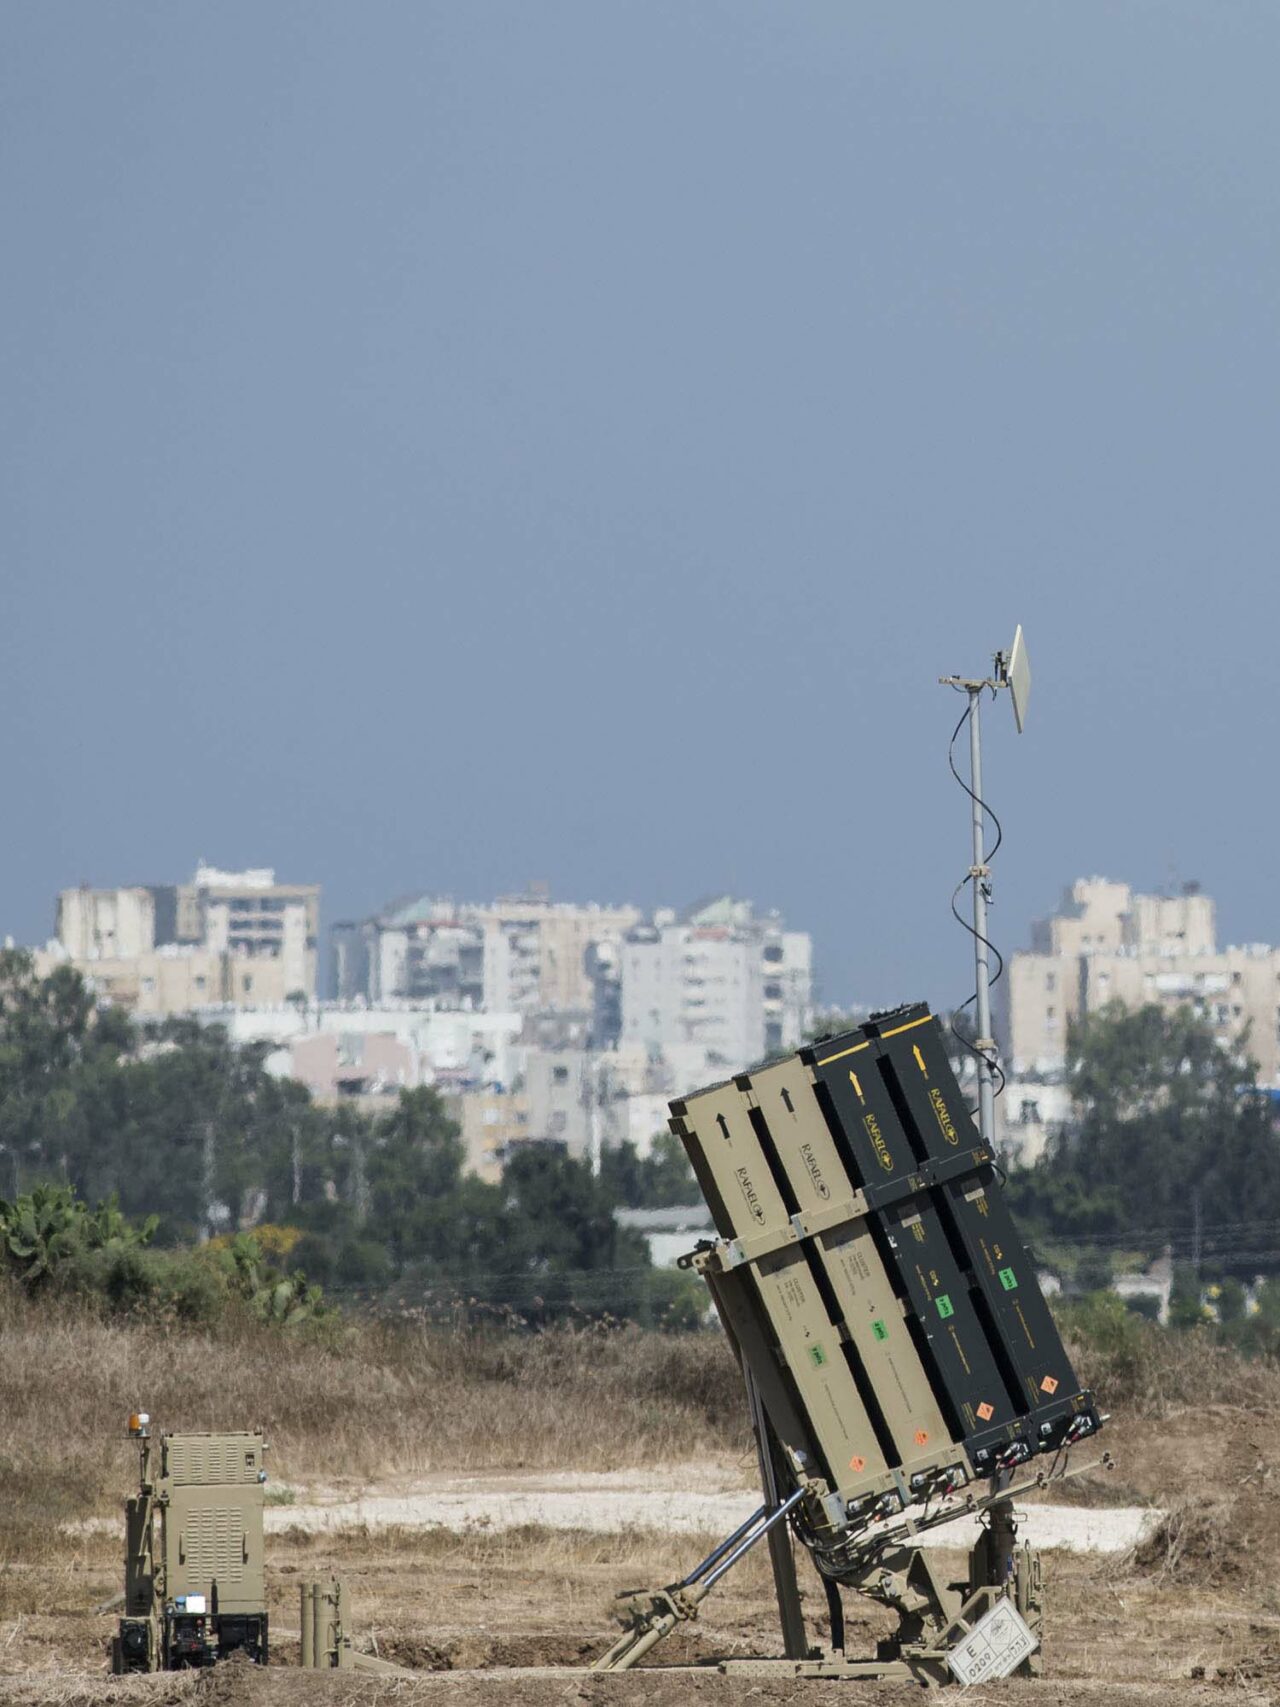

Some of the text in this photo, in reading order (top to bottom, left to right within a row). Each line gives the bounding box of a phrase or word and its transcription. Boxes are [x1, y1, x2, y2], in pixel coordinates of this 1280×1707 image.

[931, 1088, 951, 1126] RAFAEL
[865, 1114, 886, 1152] RAFAEL
[802, 1143, 822, 1182] RAFAEL
[737, 1166, 759, 1206] RAFAEL
[966, 1645, 977, 1659] E
[969, 1652, 991, 1677] 0209
